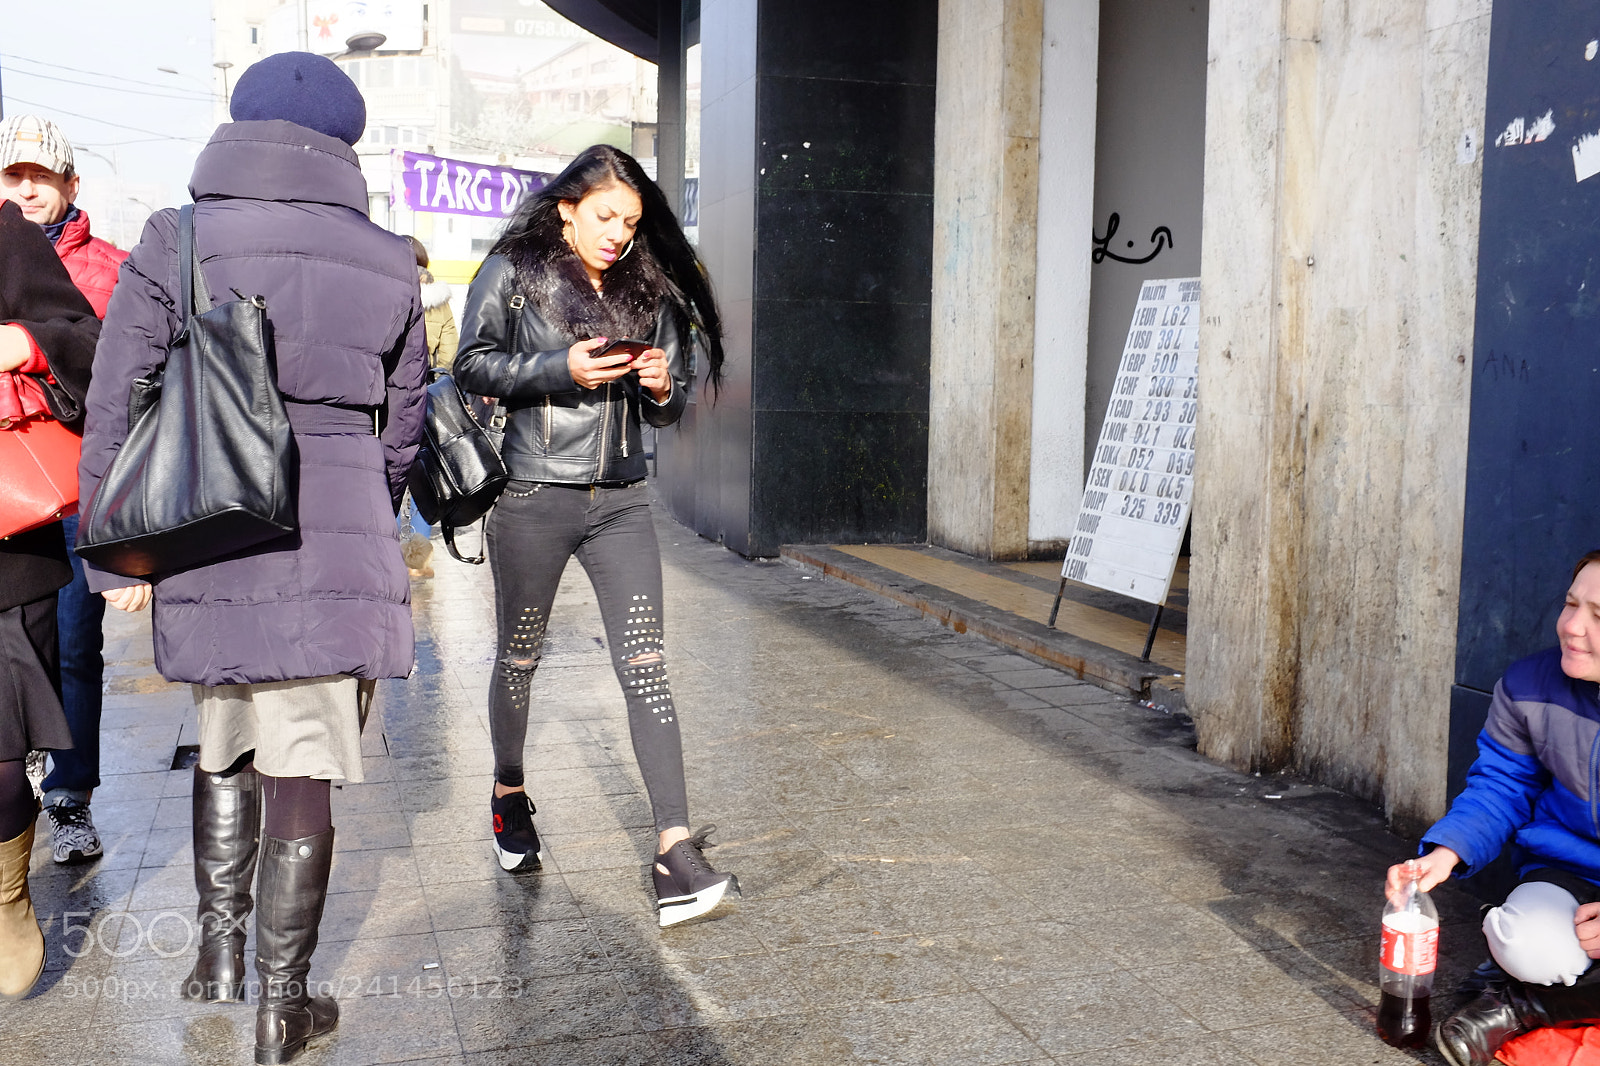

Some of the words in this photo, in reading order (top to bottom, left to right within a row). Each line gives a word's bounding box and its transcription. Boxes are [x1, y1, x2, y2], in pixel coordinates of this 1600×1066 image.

[1141, 285, 1167, 301] VALUTA
[1151, 352, 1179, 374] 500
[1148, 375, 1174, 397] 380
[1142, 400, 1171, 422] 293
[1127, 447, 1154, 470] 052
[1120, 494, 1147, 519] 325
[1153, 501, 1182, 525] 339
